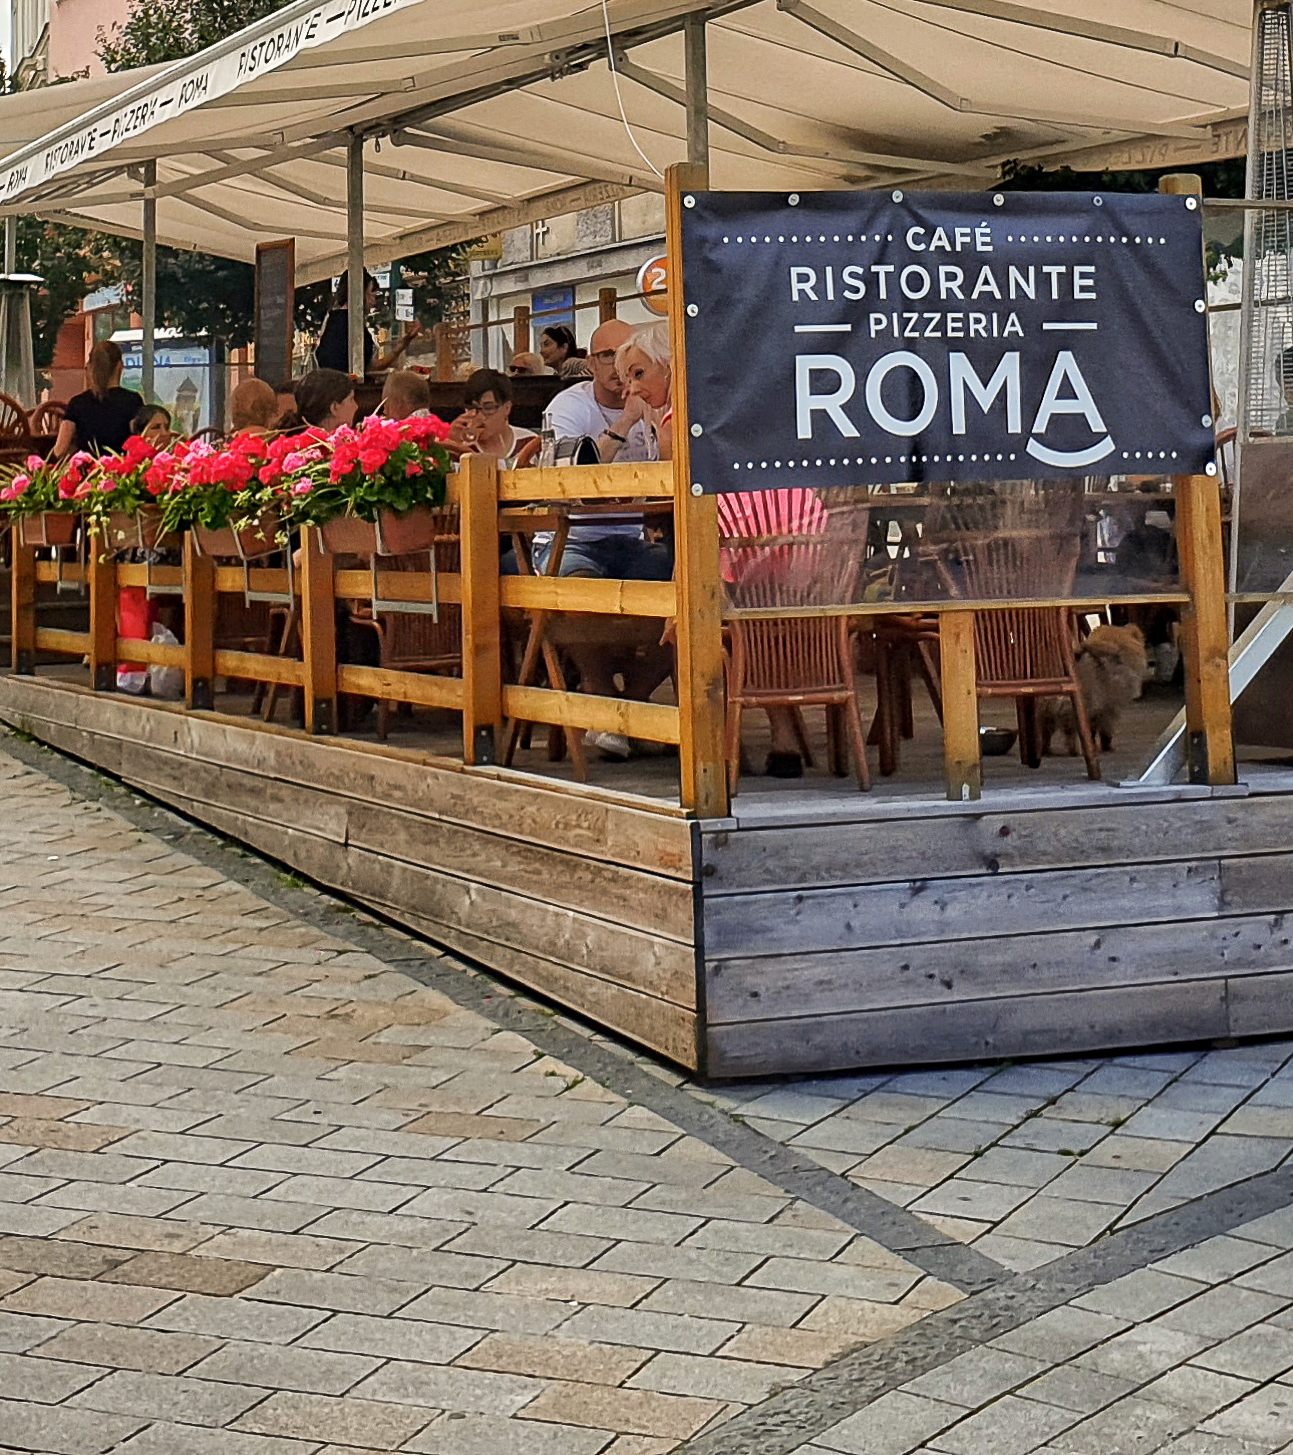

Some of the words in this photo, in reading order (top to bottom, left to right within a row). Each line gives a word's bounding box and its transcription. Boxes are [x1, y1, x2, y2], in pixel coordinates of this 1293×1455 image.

[237, 12, 322, 78] RISTORANTE
[906, 221, 994, 253] CAFÉ
[789, 264, 1098, 302] RISTORANTE
[869, 312, 1025, 338] PIZZERIA
[795, 350, 1108, 440] ROMA
